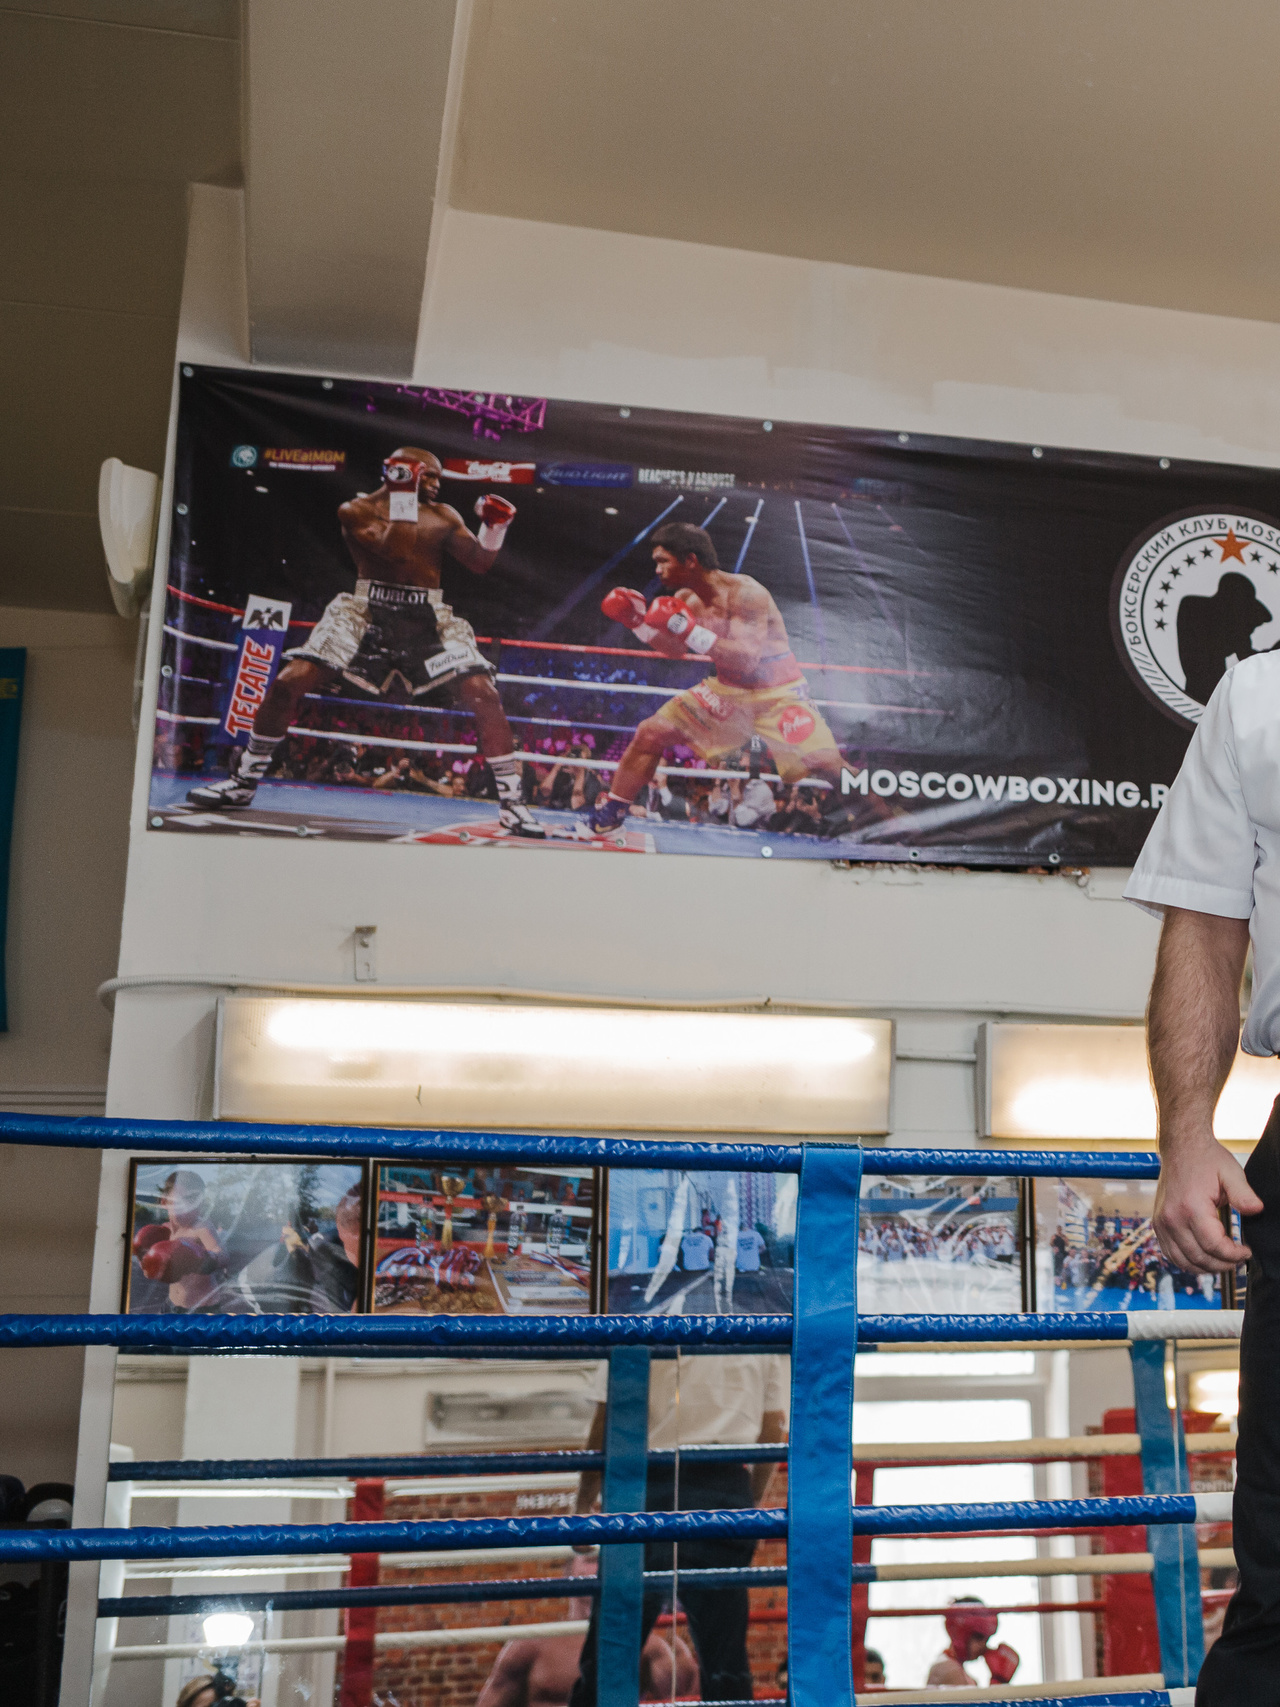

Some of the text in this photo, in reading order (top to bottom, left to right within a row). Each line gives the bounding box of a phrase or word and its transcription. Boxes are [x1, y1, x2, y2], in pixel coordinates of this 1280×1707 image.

[1126, 518, 1228, 645] БОКСЕРСКИЙ КЛУБ
[225, 635, 275, 738] TECATE
